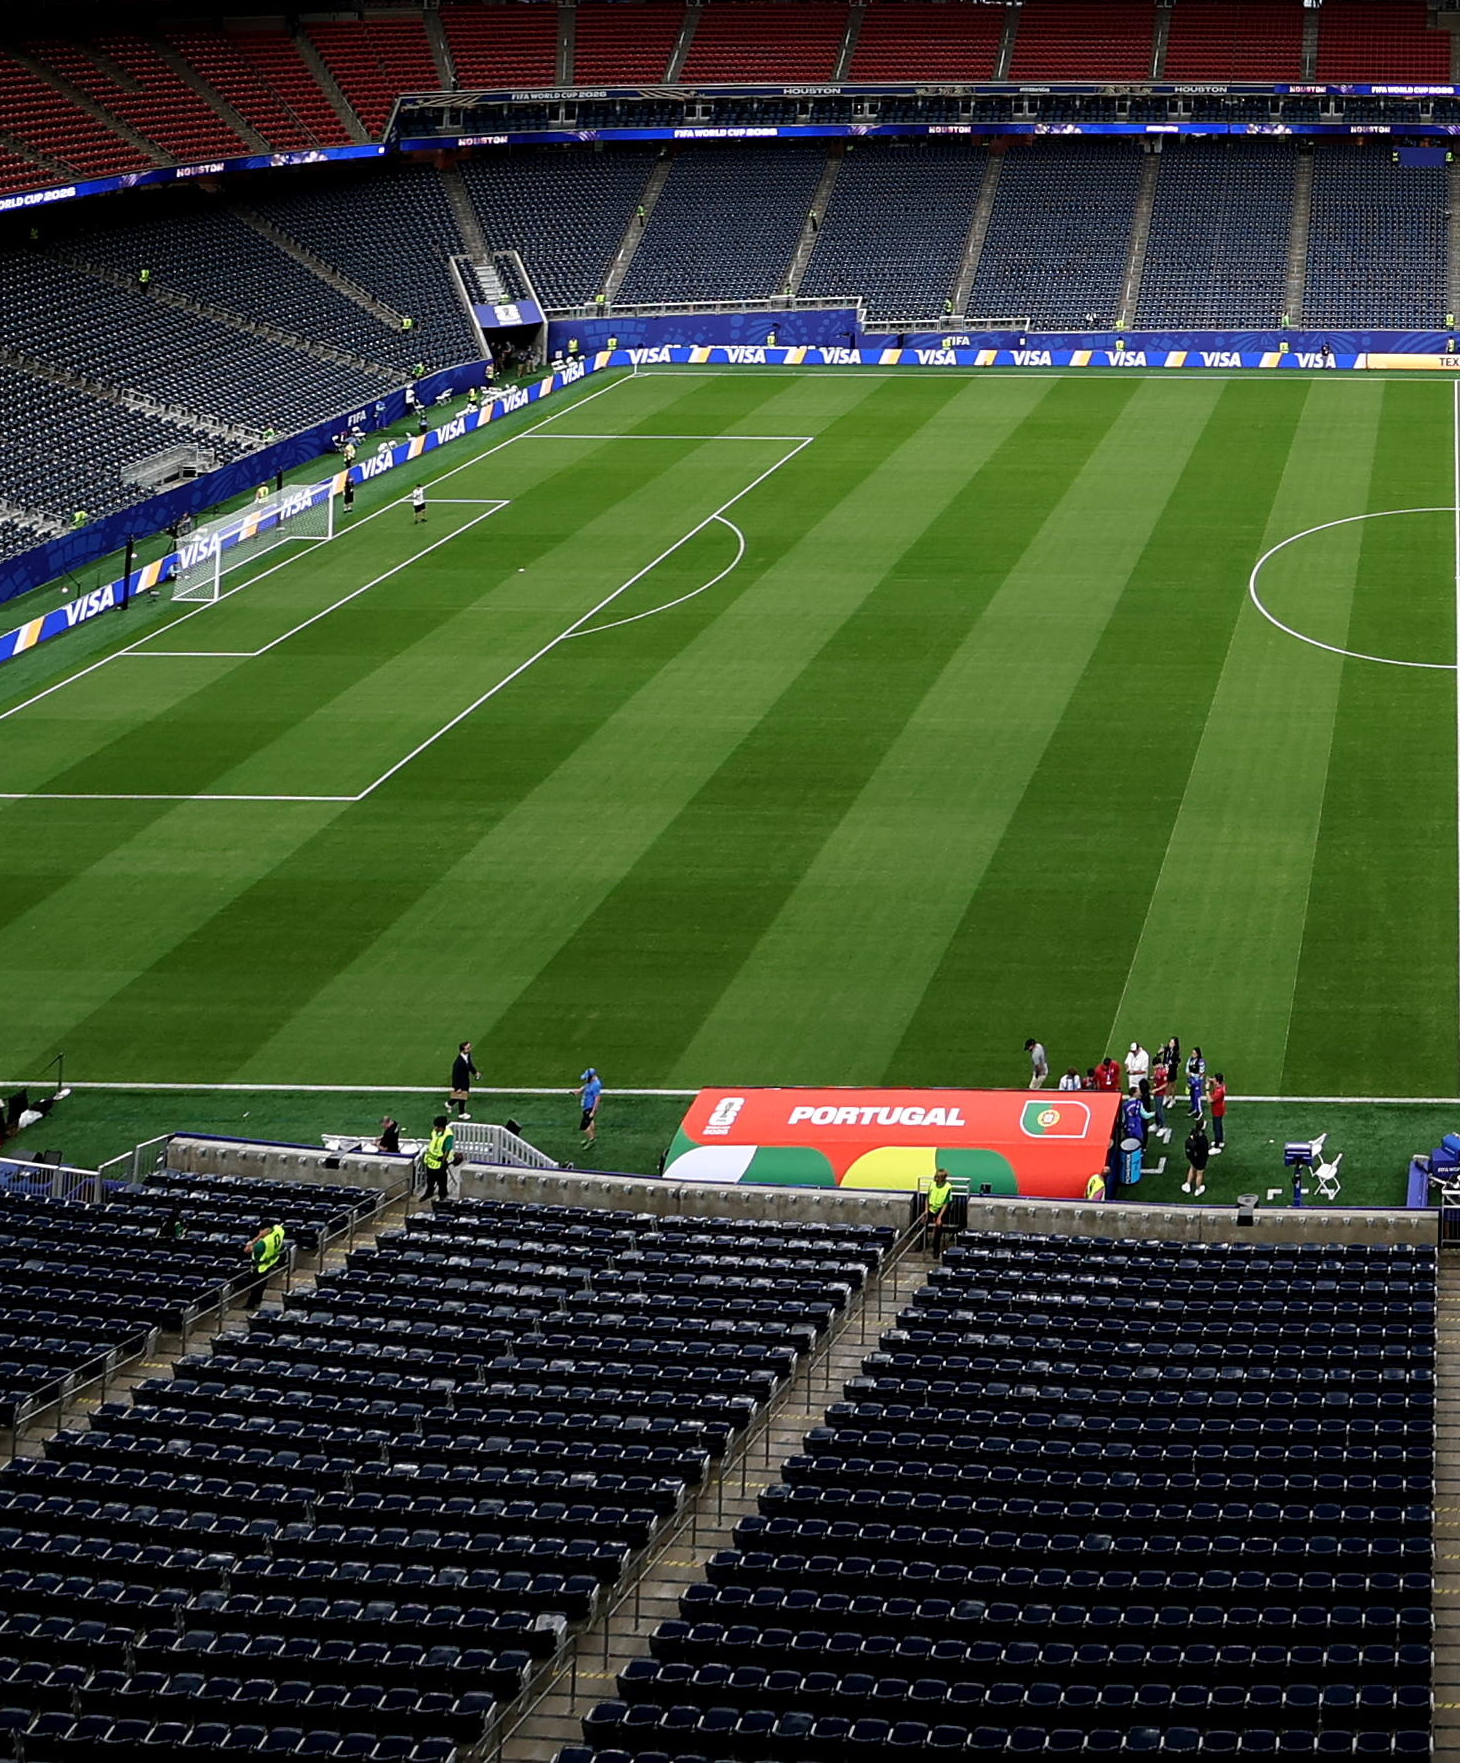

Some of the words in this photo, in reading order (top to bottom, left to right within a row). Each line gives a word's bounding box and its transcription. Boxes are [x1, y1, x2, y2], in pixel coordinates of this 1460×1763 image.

[458, 136, 508, 146] HOUSTON
[674, 129, 695, 138] FIFA
[696, 128, 725, 137] WORLD
[726, 128, 745, 137] CUP
[176, 162, 224, 177] HOUSTON
[24, 192, 43, 205] CUP
[43, 187, 75, 202] 2026
[625, 348, 671, 364] VISA
[724, 348, 766, 364] VISA
[819, 348, 861, 364] VISA
[915, 349, 956, 365] VISA
[1010, 350, 1051, 366] VISA
[1105, 351, 1146, 366] VISA
[1200, 352, 1241, 368] VISA
[1294, 353, 1336, 368] VISA
[561, 362, 585, 386] VISA
[501, 388, 528, 414] VISA
[347, 410, 367, 428] FIFA
[436, 417, 465, 444] VISA
[360, 451, 393, 479] VISA
[178, 533, 219, 569] VISA
[65, 587, 115, 627] VISA
[787, 1106, 966, 1126] PORTUGAL
